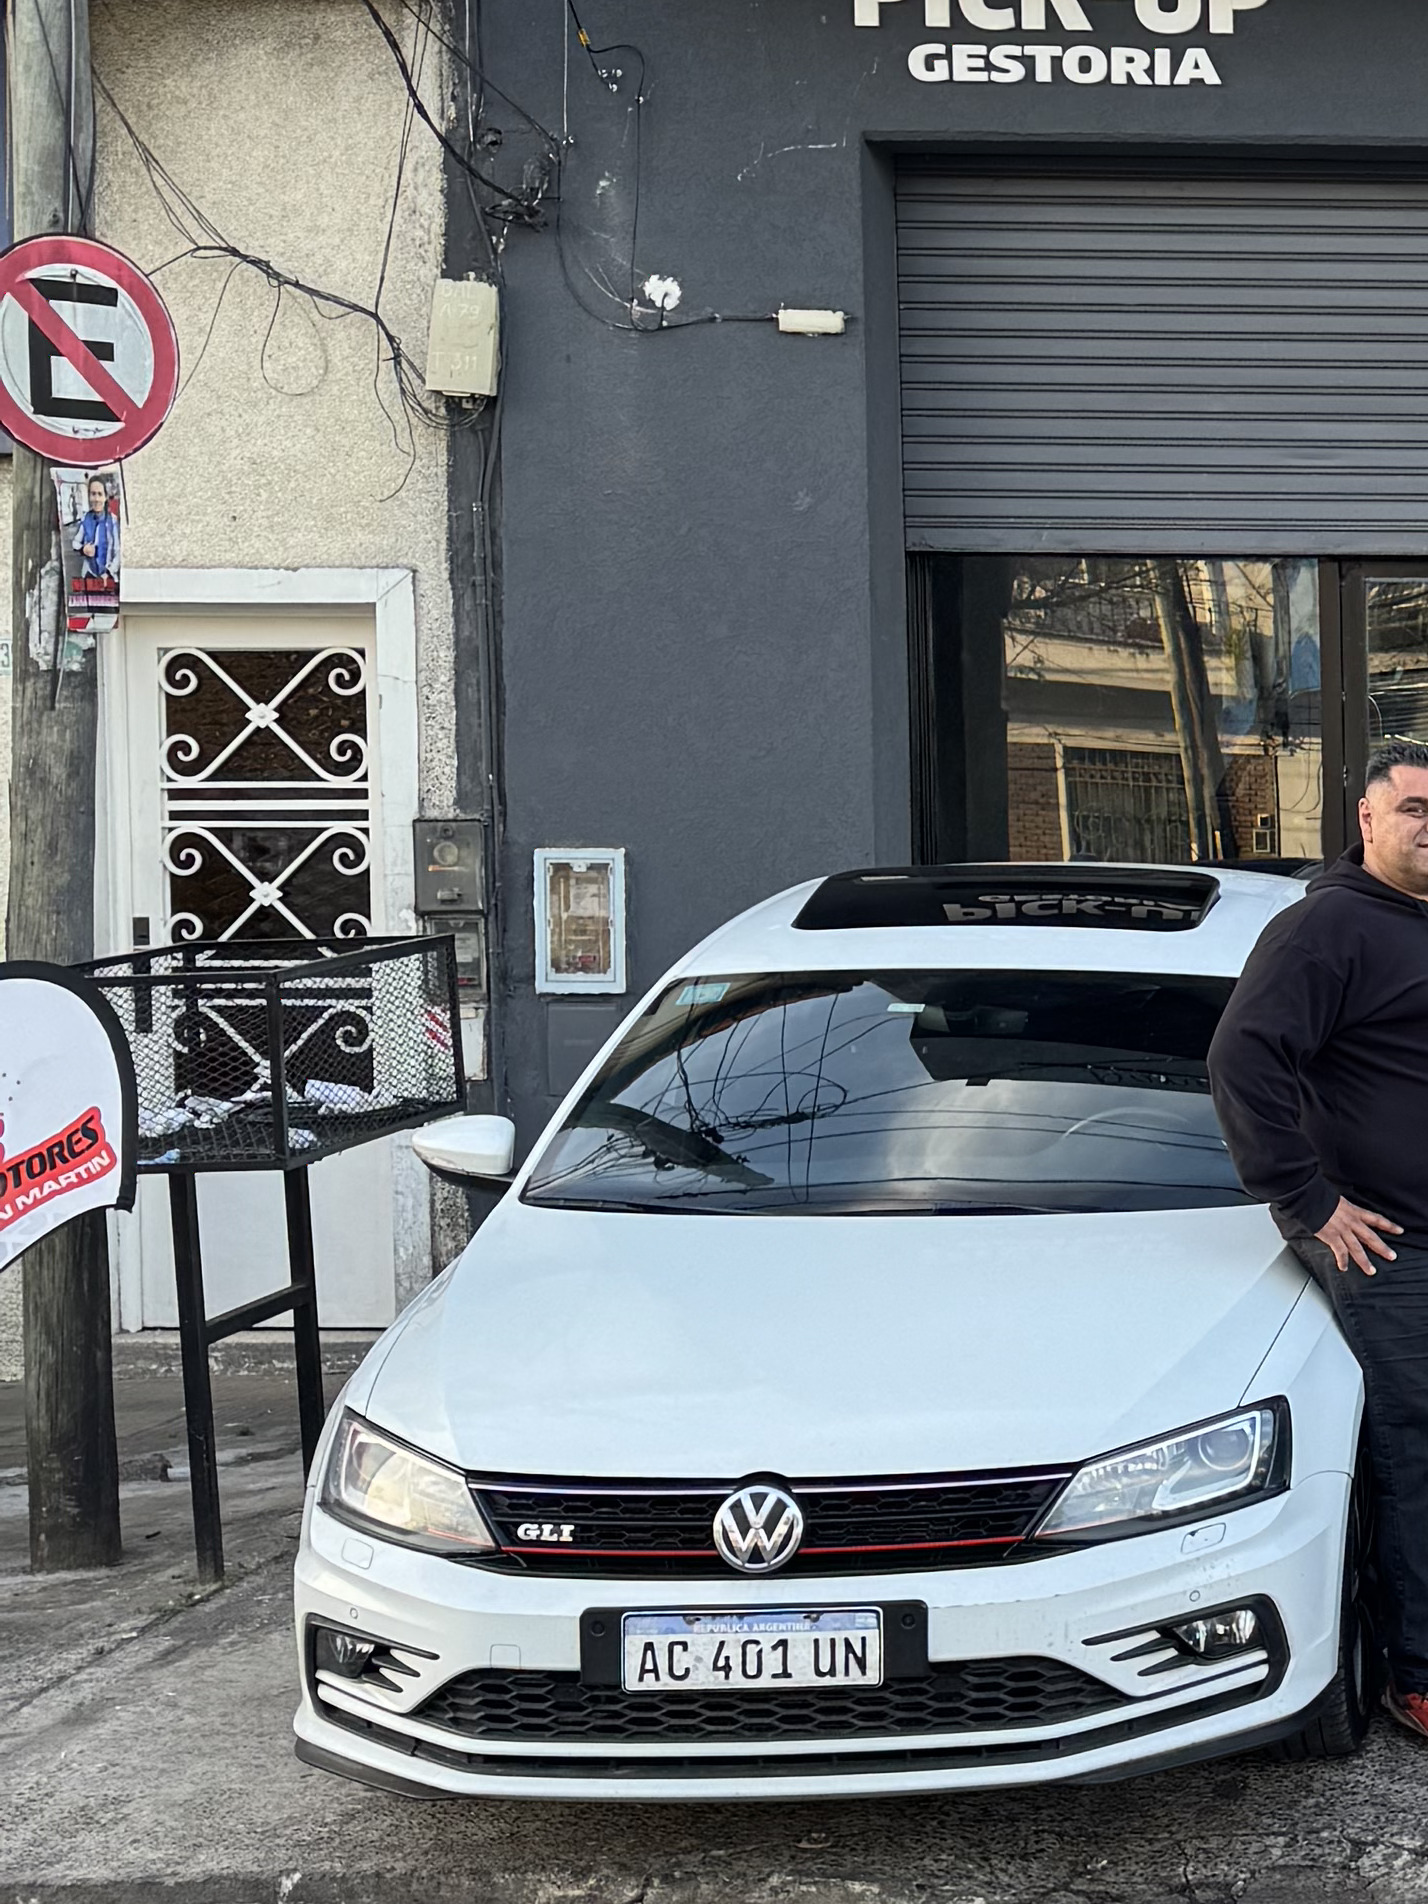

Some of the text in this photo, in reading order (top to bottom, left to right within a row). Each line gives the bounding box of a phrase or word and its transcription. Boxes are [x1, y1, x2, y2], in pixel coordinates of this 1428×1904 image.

[907, 42, 1222, 87] GESTORIA
[15, 1149, 111, 1211] MARTIN
[516, 1522, 576, 1543] GLI
[637, 1635, 868, 1684] AC 401 UN
